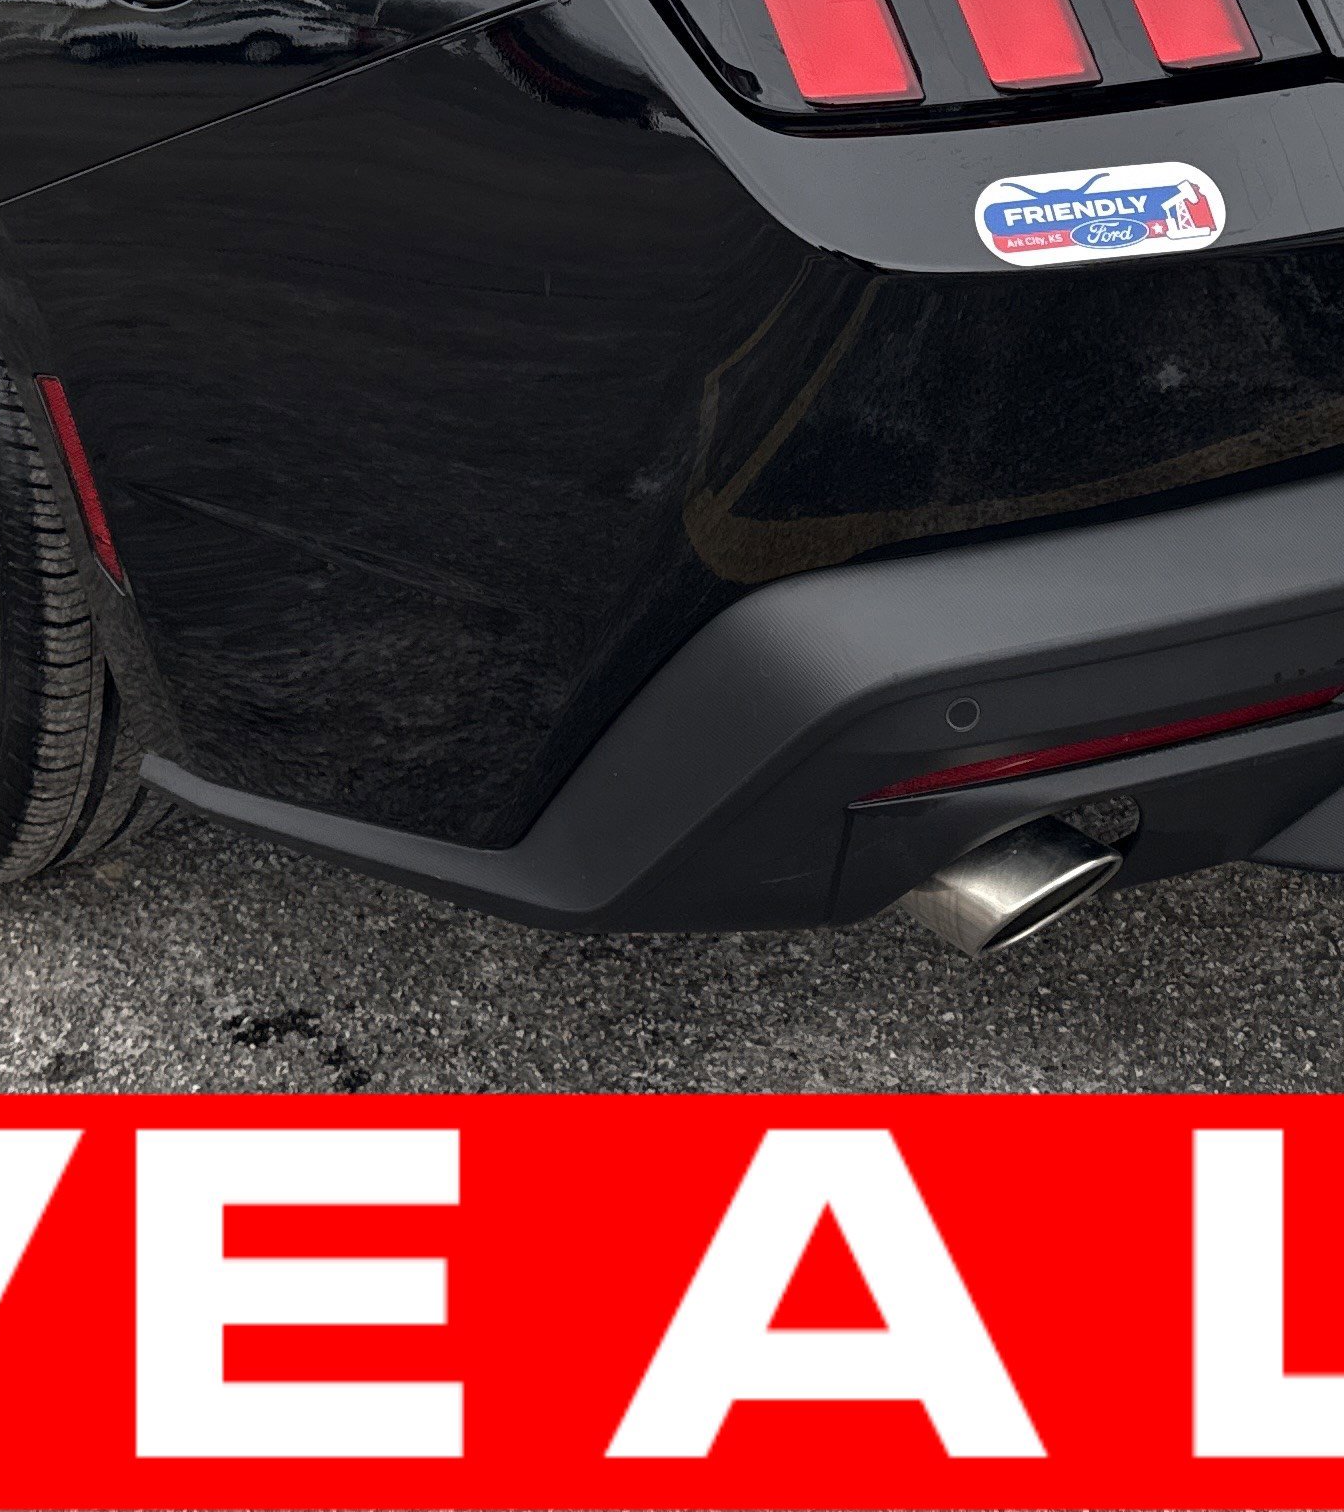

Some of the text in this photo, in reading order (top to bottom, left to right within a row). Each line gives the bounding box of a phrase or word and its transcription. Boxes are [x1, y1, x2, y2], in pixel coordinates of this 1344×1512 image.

[1003, 195, 1147, 227] FRIENDLY
[1007, 235, 1025, 248] Ark
[1047, 233, 1063, 243] KS
[1087, 221, 1133, 243] Ford
